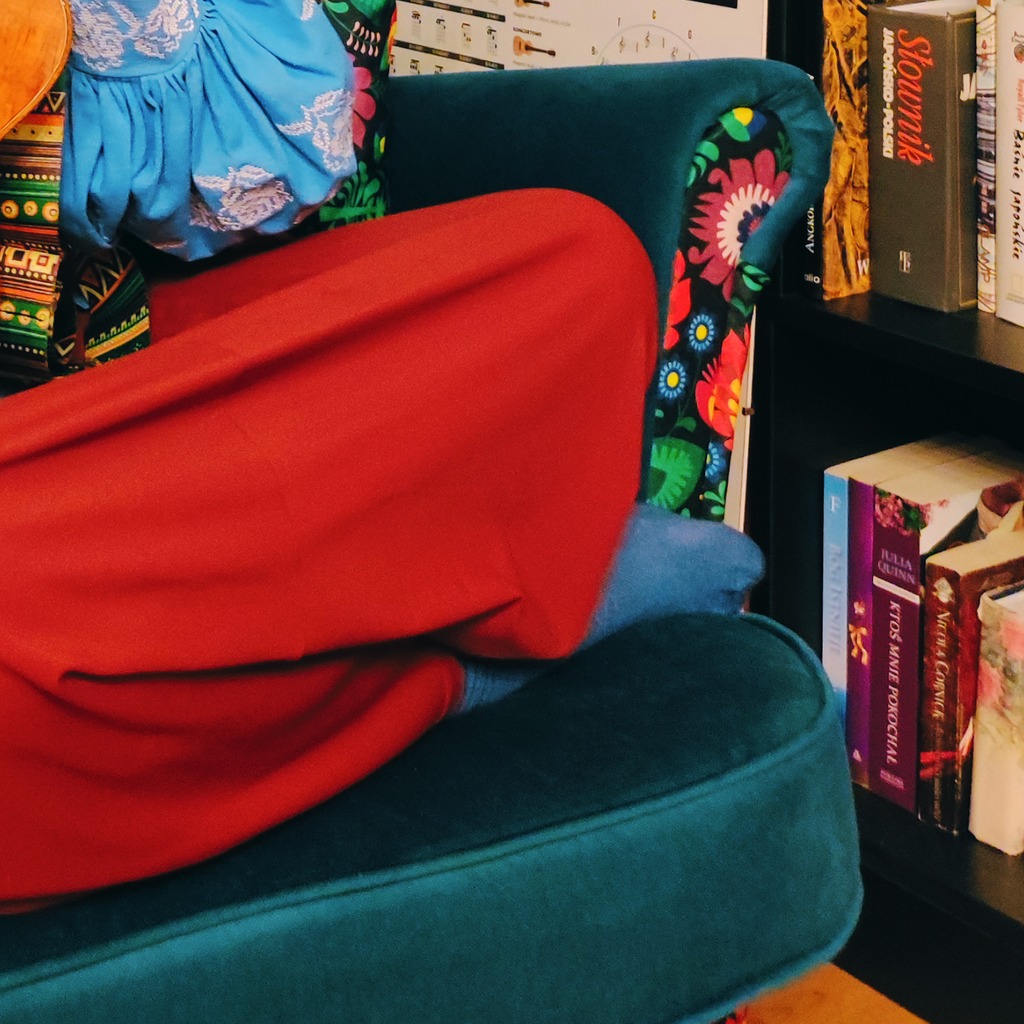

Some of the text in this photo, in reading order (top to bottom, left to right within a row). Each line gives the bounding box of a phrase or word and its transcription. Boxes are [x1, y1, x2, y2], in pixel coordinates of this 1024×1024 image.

[897, 28, 935, 166] Słownik
[1012, 129, 1024, 179] Baśnie
[877, 561, 916, 586] QUINN
[880, 549, 913, 573] JULIA
[889, 600, 902, 642] KTOŚ
[888, 642, 901, 685] MNIE
[886, 685, 900, 766] POKOCHAŁ
